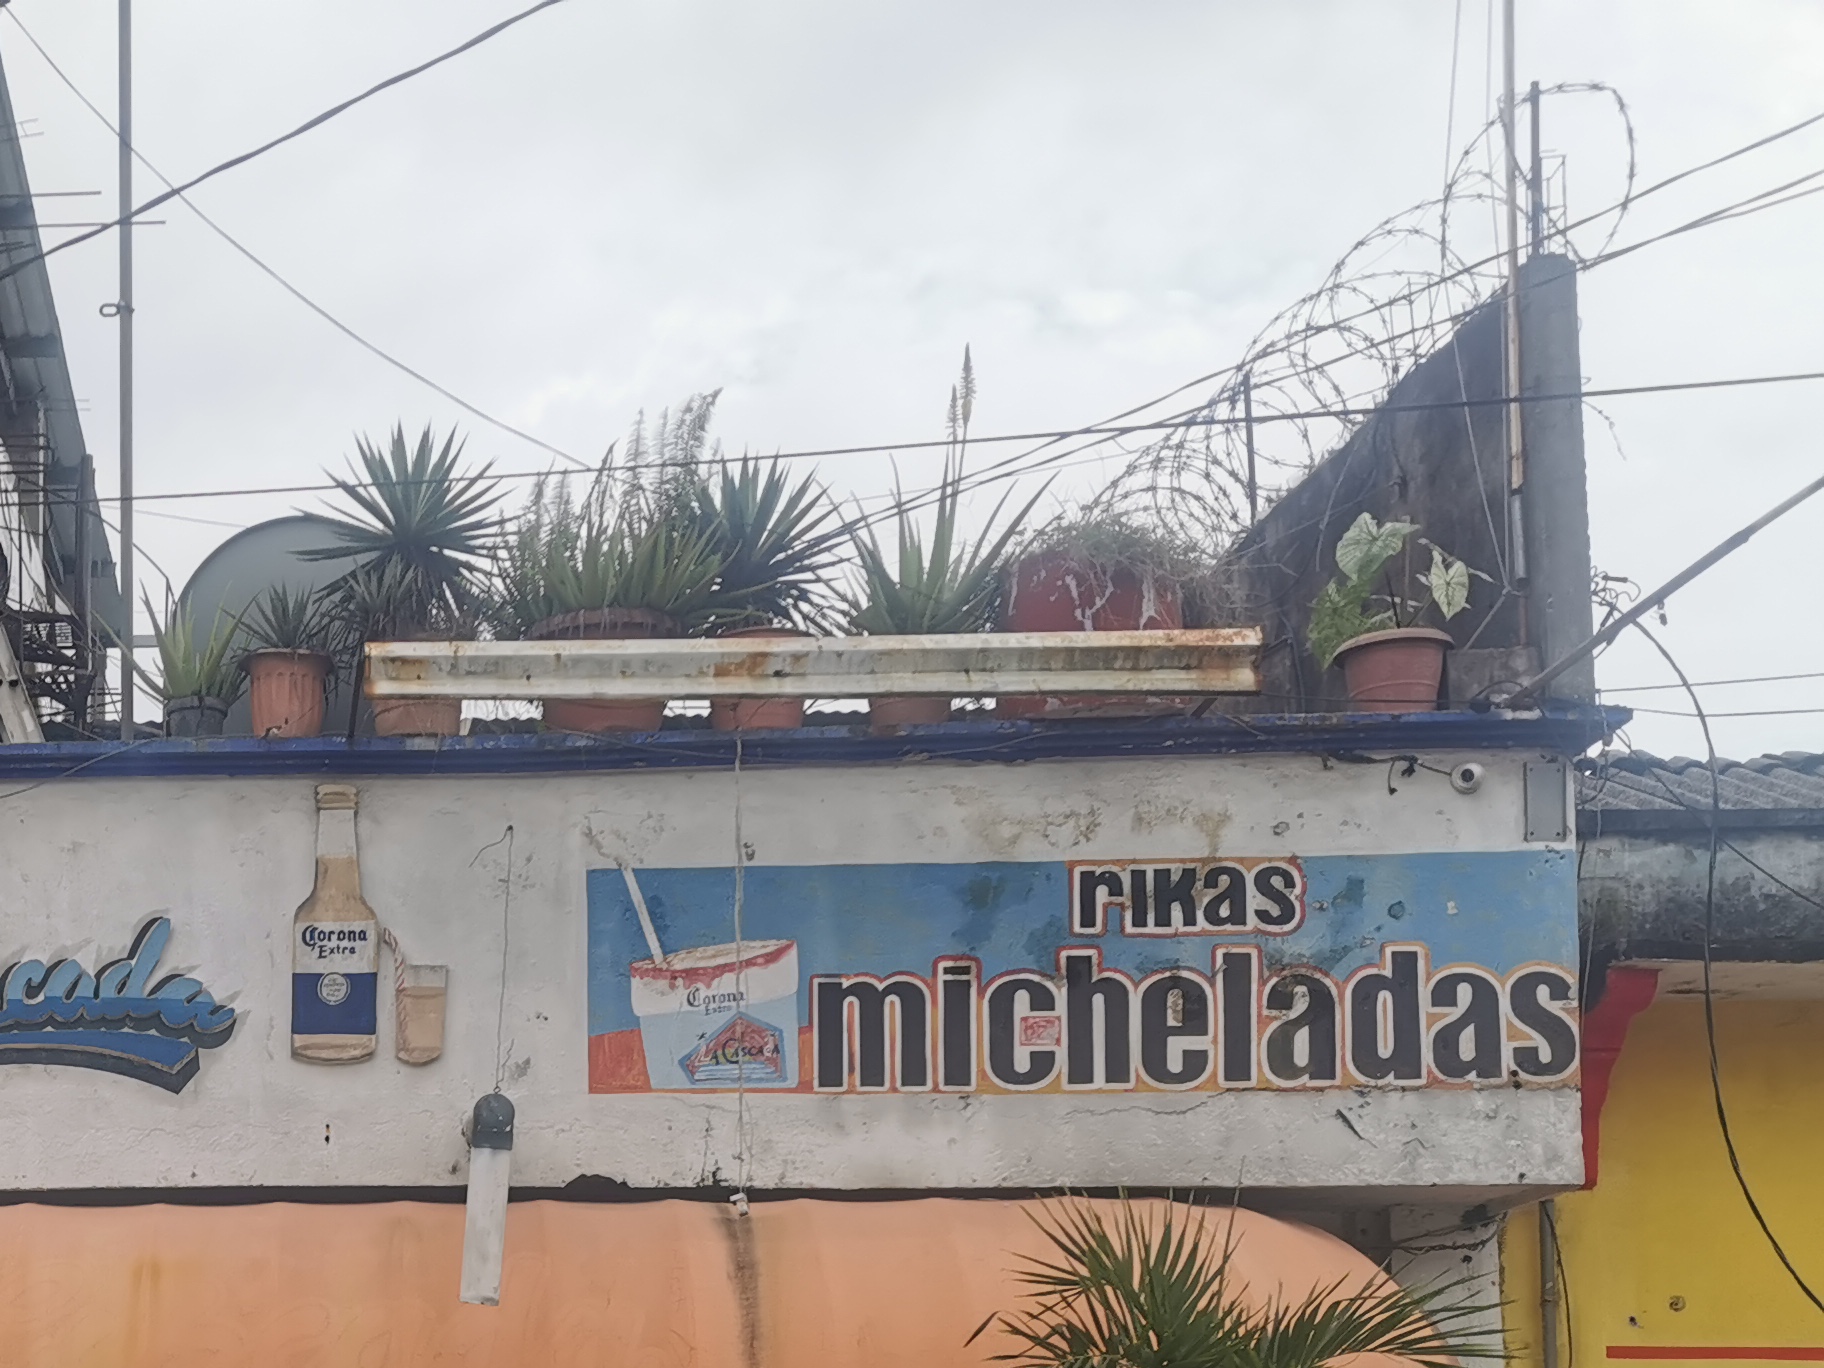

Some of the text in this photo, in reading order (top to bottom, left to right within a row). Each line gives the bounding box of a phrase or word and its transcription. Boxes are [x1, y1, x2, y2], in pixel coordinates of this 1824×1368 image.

[301, 924, 368, 952] Corona
[316, 944, 357, 959] Extra
[687, 985, 746, 1008] Corona
[816, 947, 1578, 1088] micheladas
